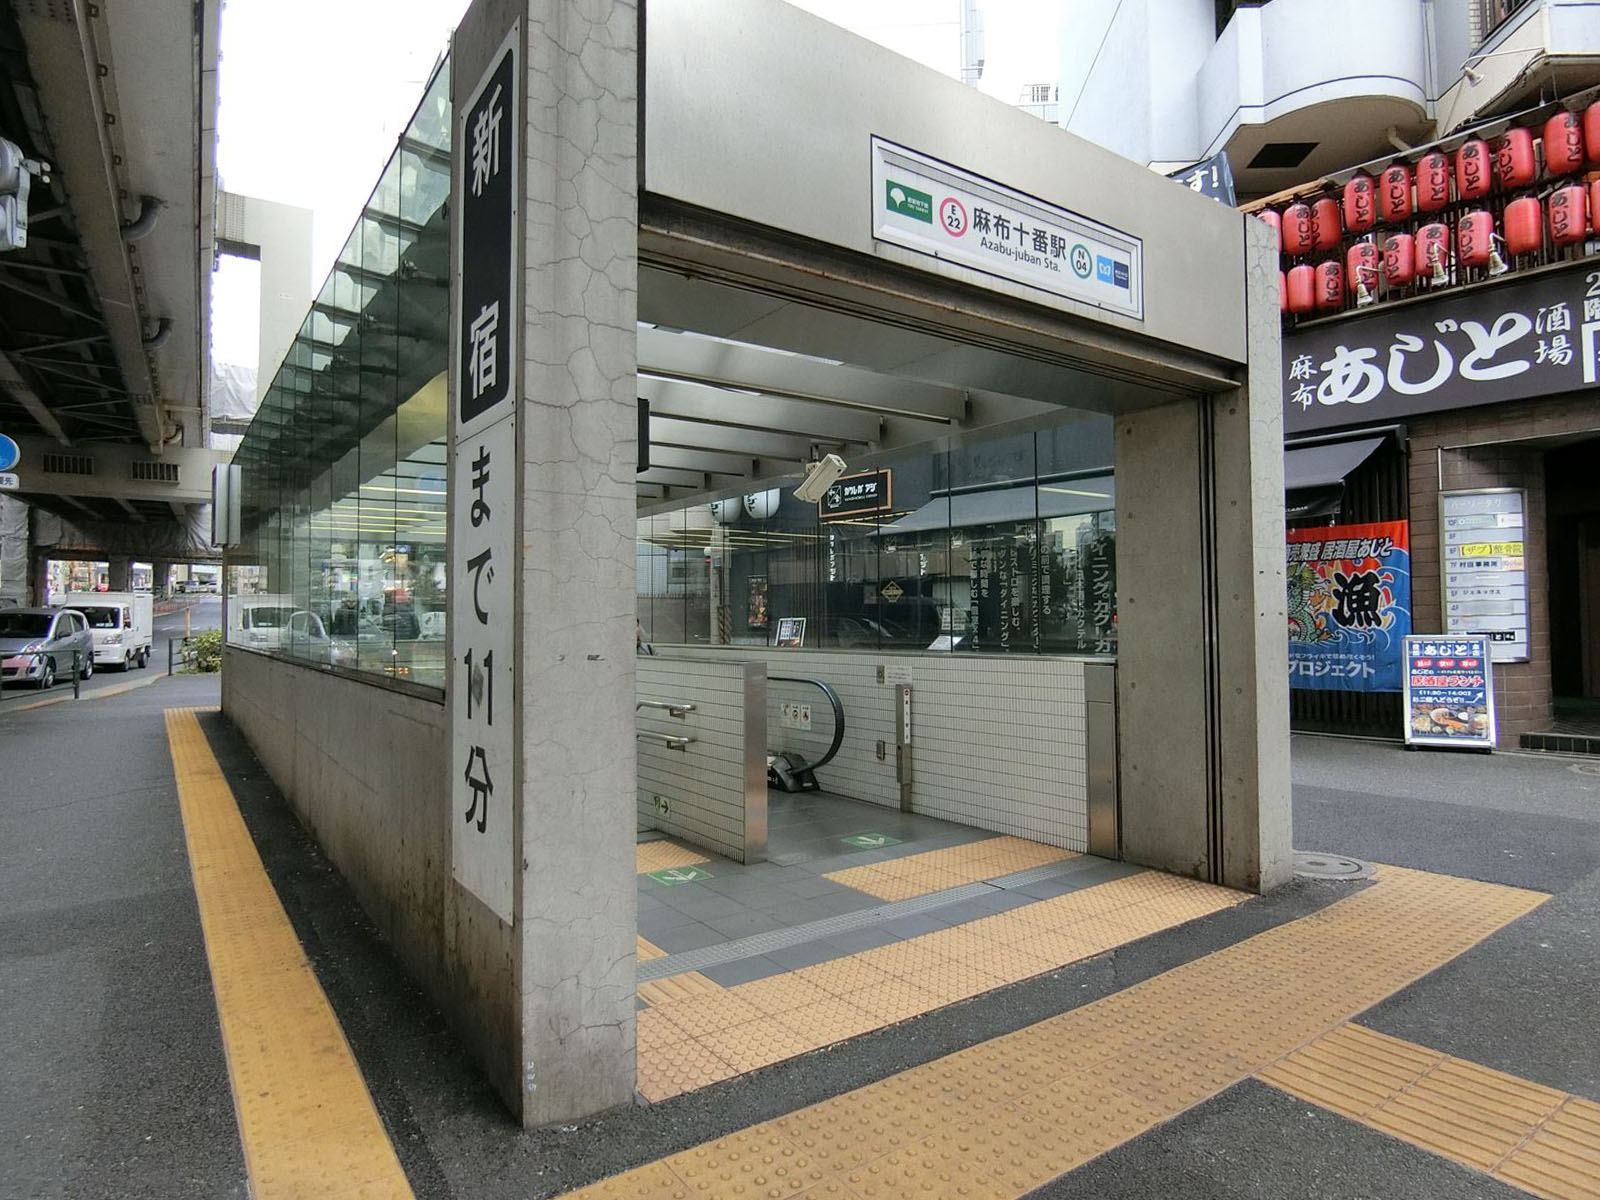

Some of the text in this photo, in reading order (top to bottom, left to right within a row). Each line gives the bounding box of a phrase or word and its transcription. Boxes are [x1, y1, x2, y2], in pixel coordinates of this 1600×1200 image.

[947, 215, 961, 230] 22
[951, 205, 956, 215] E
[973, 207, 1067, 261] 麻布十番駅
[469, 83, 503, 400] 新宿
[980, 236, 1061, 272] Azabu-juban Sta.
[1076, 260, 1087, 272] 04
[1078, 250, 1085, 260] N
[1316, 312, 1533, 406] あじと
[1534, 302, 1573, 366] 酒場
[1288, 354, 1319, 411] 麻布
[1332, 571, 1382, 628] 漁
